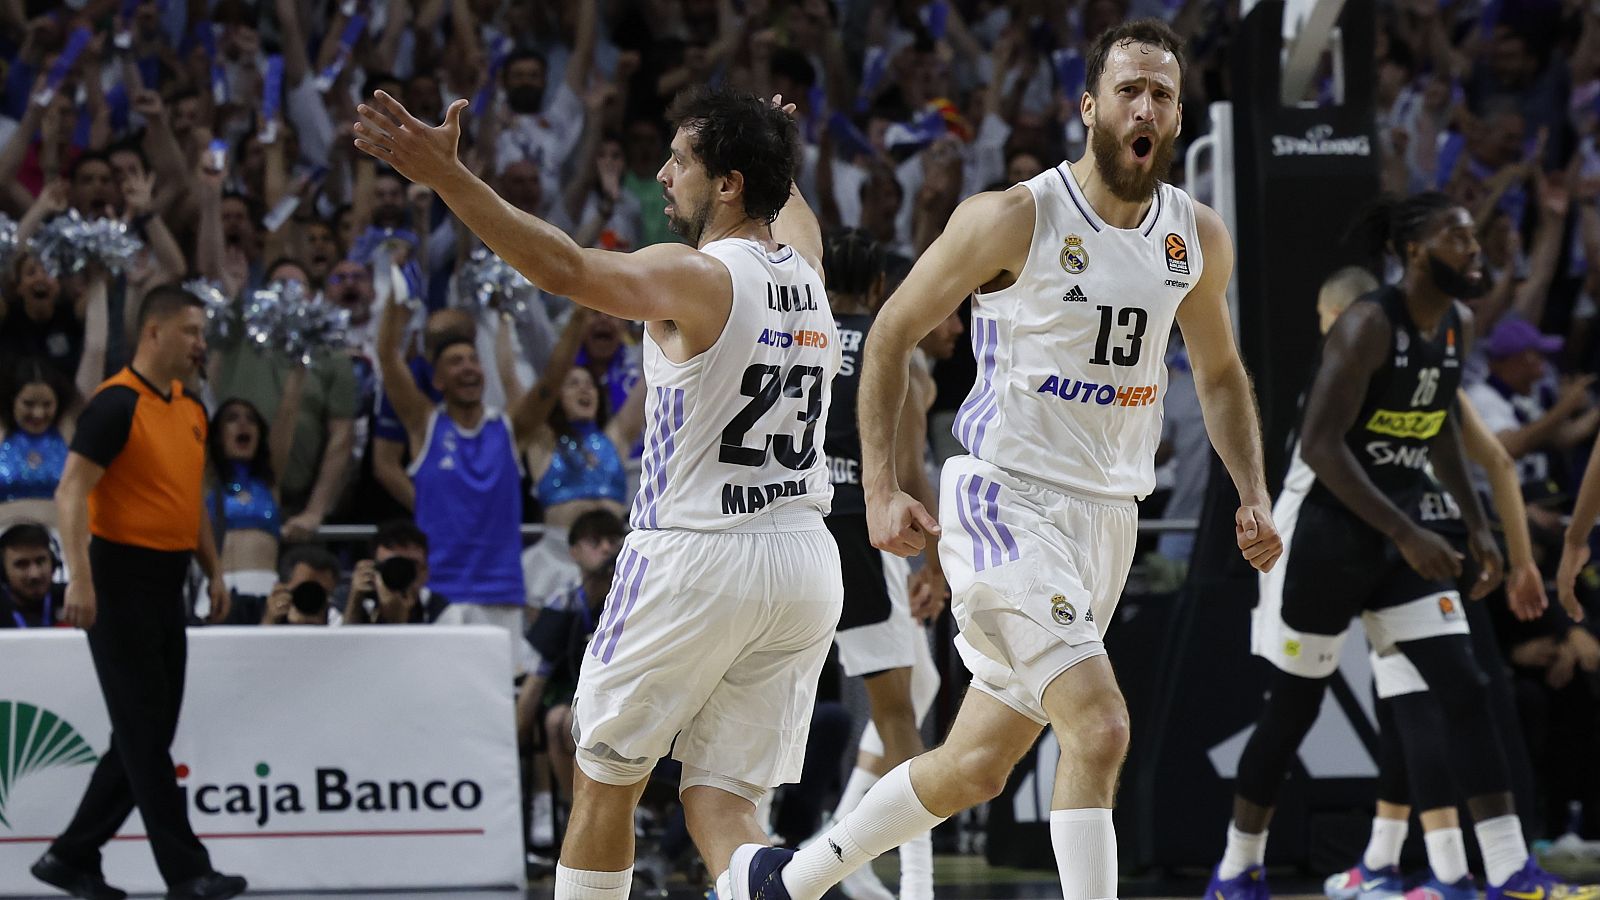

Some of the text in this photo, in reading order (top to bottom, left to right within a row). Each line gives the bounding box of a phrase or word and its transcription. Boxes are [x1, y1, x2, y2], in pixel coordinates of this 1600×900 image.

[1271, 134, 1370, 157] SPALDING
[757, 328, 828, 350] AUTOHERO
[1088, 305, 1148, 367] 13
[1410, 367, 1440, 408] 26
[718, 363, 823, 471] 23
[721, 478, 807, 514] MADRI
[175, 762, 483, 828] icaja Banco
